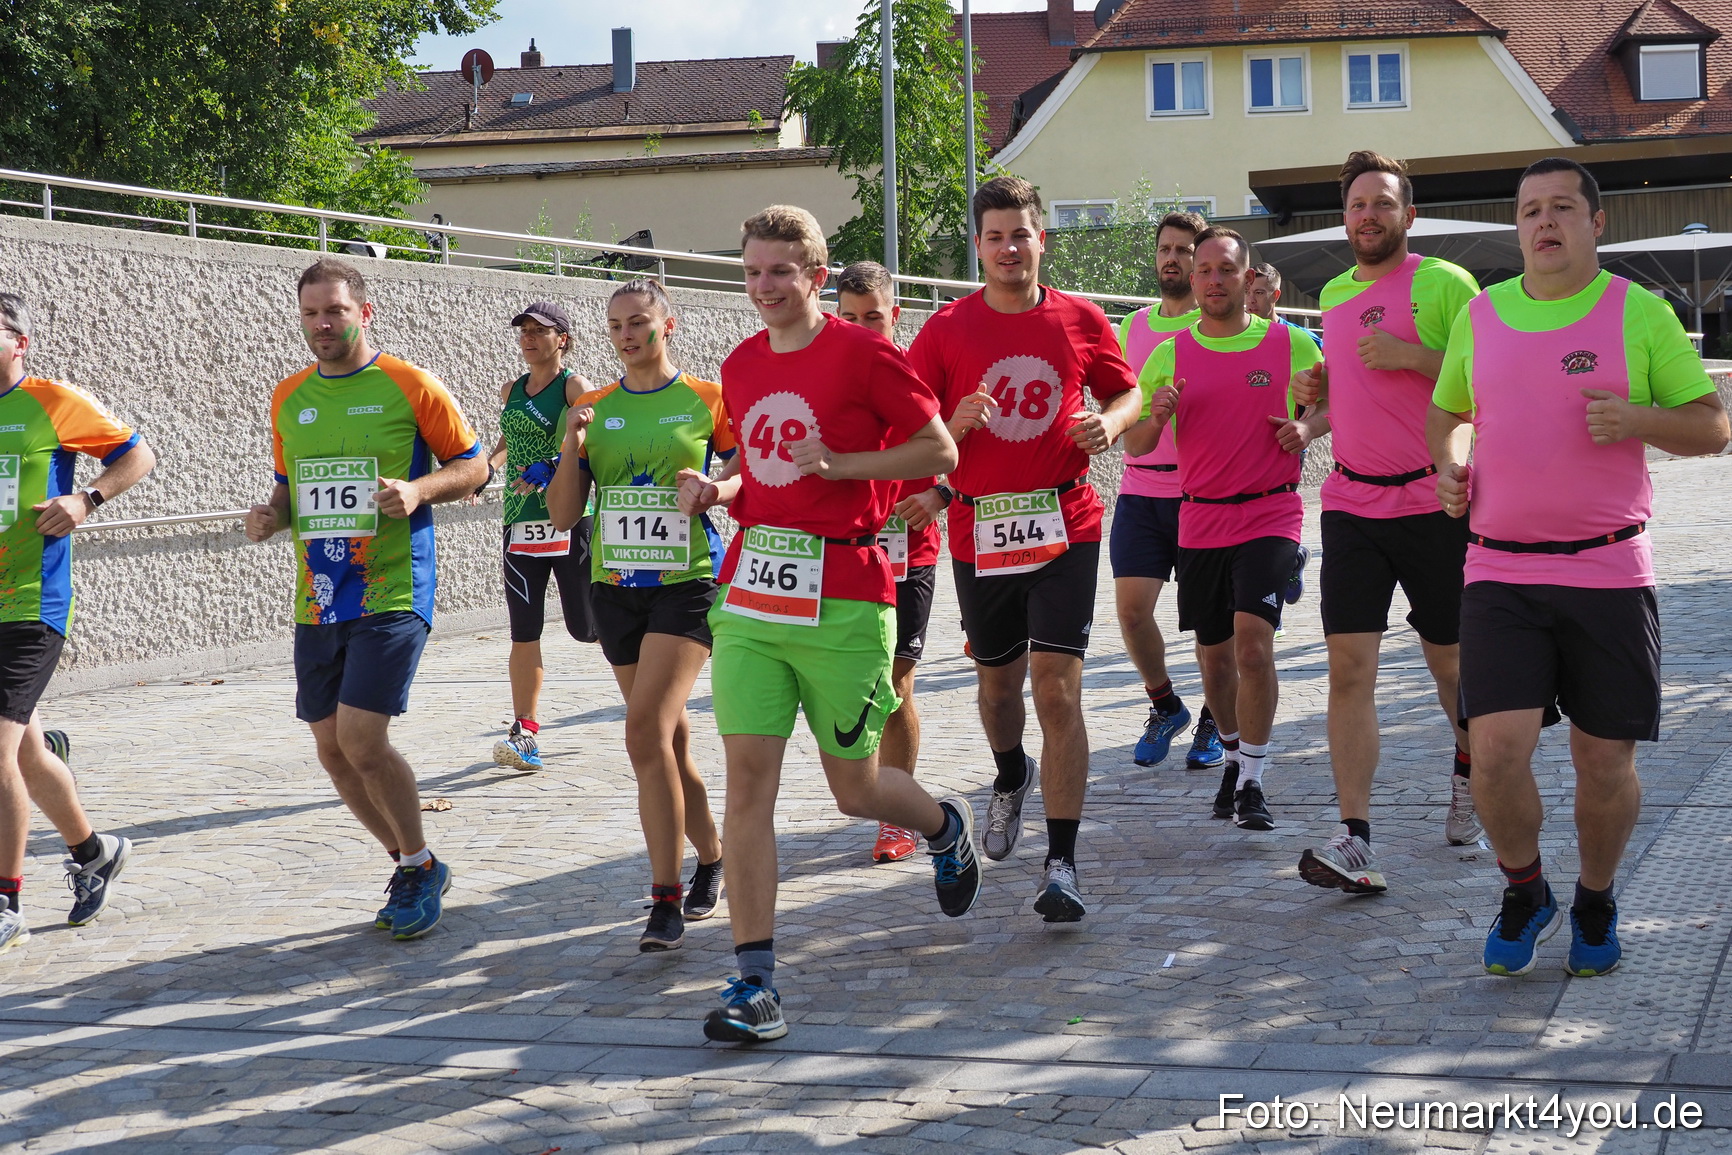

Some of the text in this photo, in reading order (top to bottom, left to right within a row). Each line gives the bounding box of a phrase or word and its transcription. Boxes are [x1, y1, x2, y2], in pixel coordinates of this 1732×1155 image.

[1060, 212, 1069, 228] APIE
[347, 405, 383, 415] BOCK
[525, 400, 552, 427] Pyraser
[659, 415, 692, 424] BOCK
[0, 424, 26, 432] OCK
[300, 461, 370, 481] BOCK
[309, 485, 358, 510] 116
[607, 490, 680, 509] BOCK
[980, 493, 1052, 518] BOCK
[308, 517, 356, 529] STEFAN
[524, 523, 557, 541] 537
[618, 516, 668, 541] 114
[747, 527, 814, 556] BOCK
[993, 520, 1045, 548] 544
[612, 548, 675, 561] VIKTORIA
[1001, 550, 1037, 566] TOBI
[747, 558, 798, 591] 546
